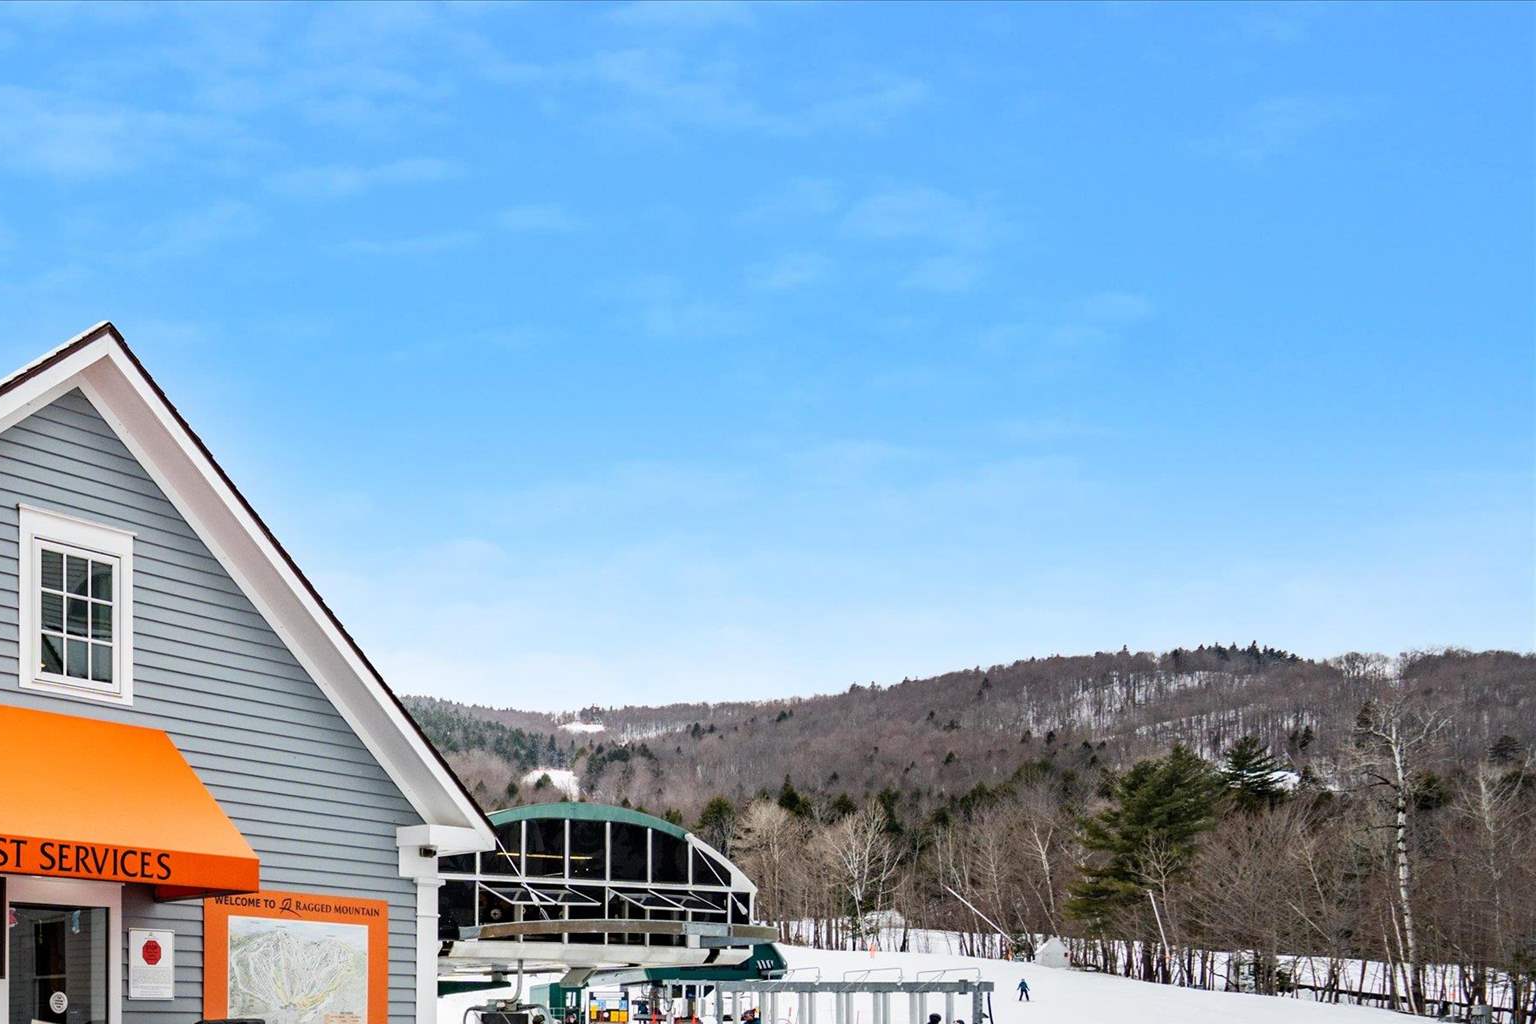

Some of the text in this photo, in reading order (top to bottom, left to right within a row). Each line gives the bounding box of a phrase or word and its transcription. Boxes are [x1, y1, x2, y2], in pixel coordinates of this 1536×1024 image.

[39, 842, 172, 880] SERVICES
[215, 897, 380, 916] WELCOME TO RAGGED MOUNTAIN
